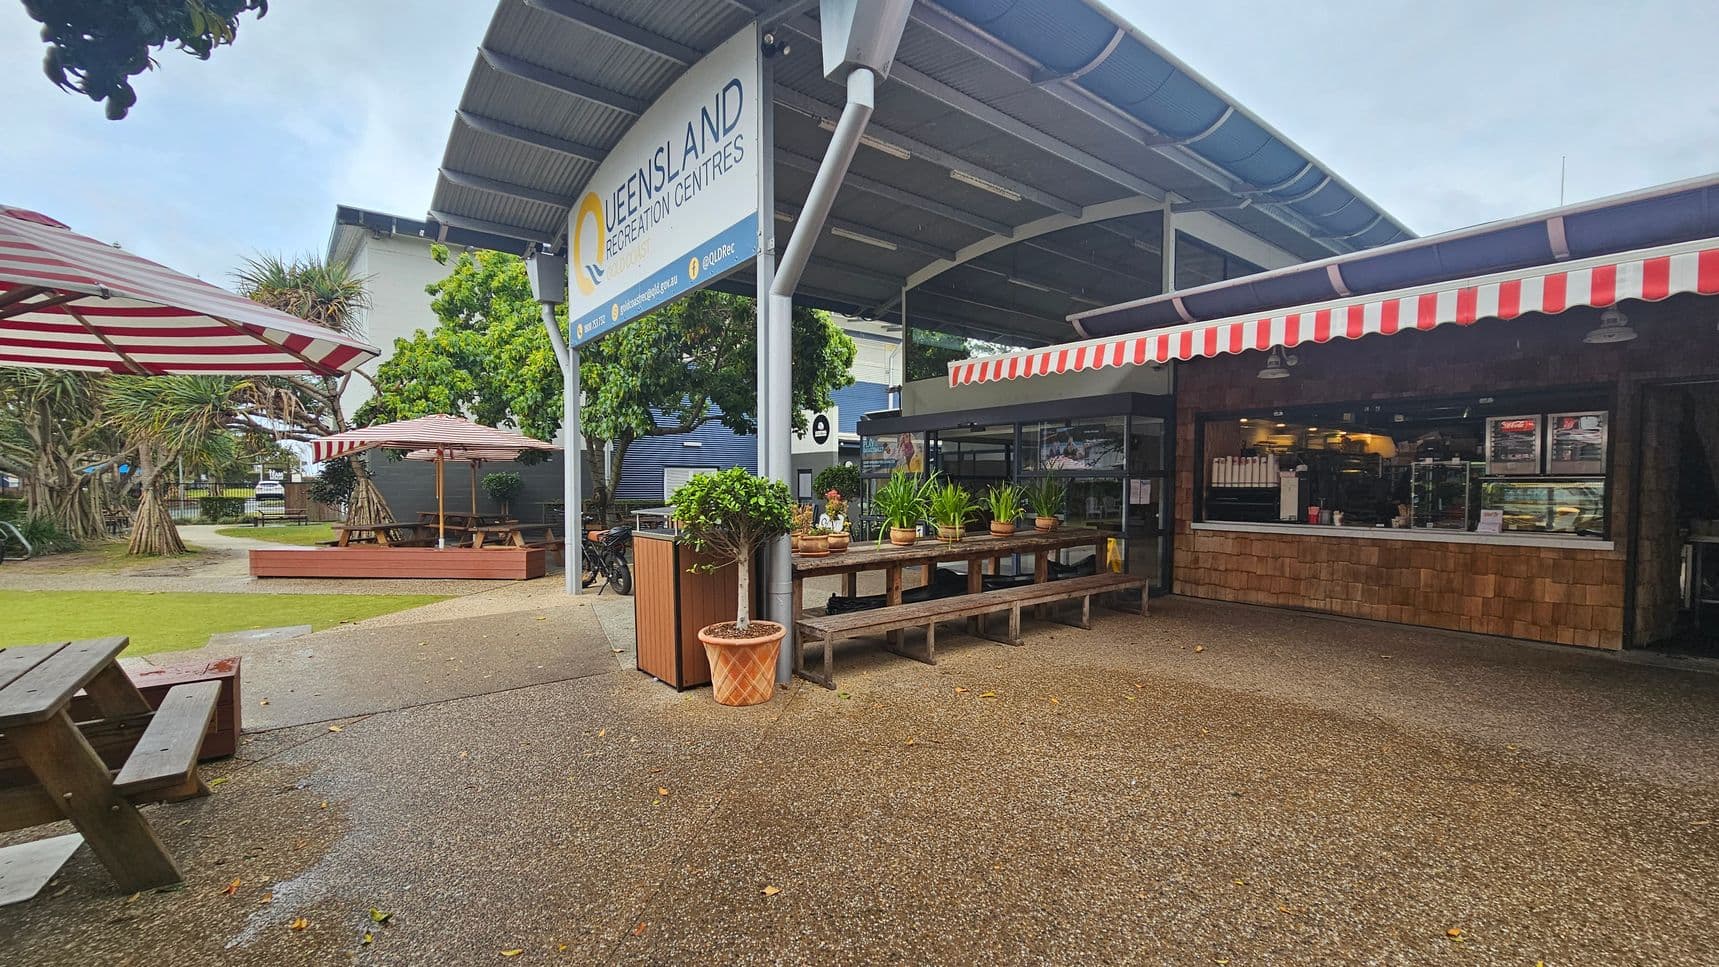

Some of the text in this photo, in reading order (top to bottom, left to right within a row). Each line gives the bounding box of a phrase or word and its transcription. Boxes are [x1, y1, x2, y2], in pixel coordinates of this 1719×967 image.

[574, 78, 743, 296] QUEENSLAND
[606, 133, 744, 260] RECREATION CENTRES
[702, 242, 735, 270] @QLDRec
